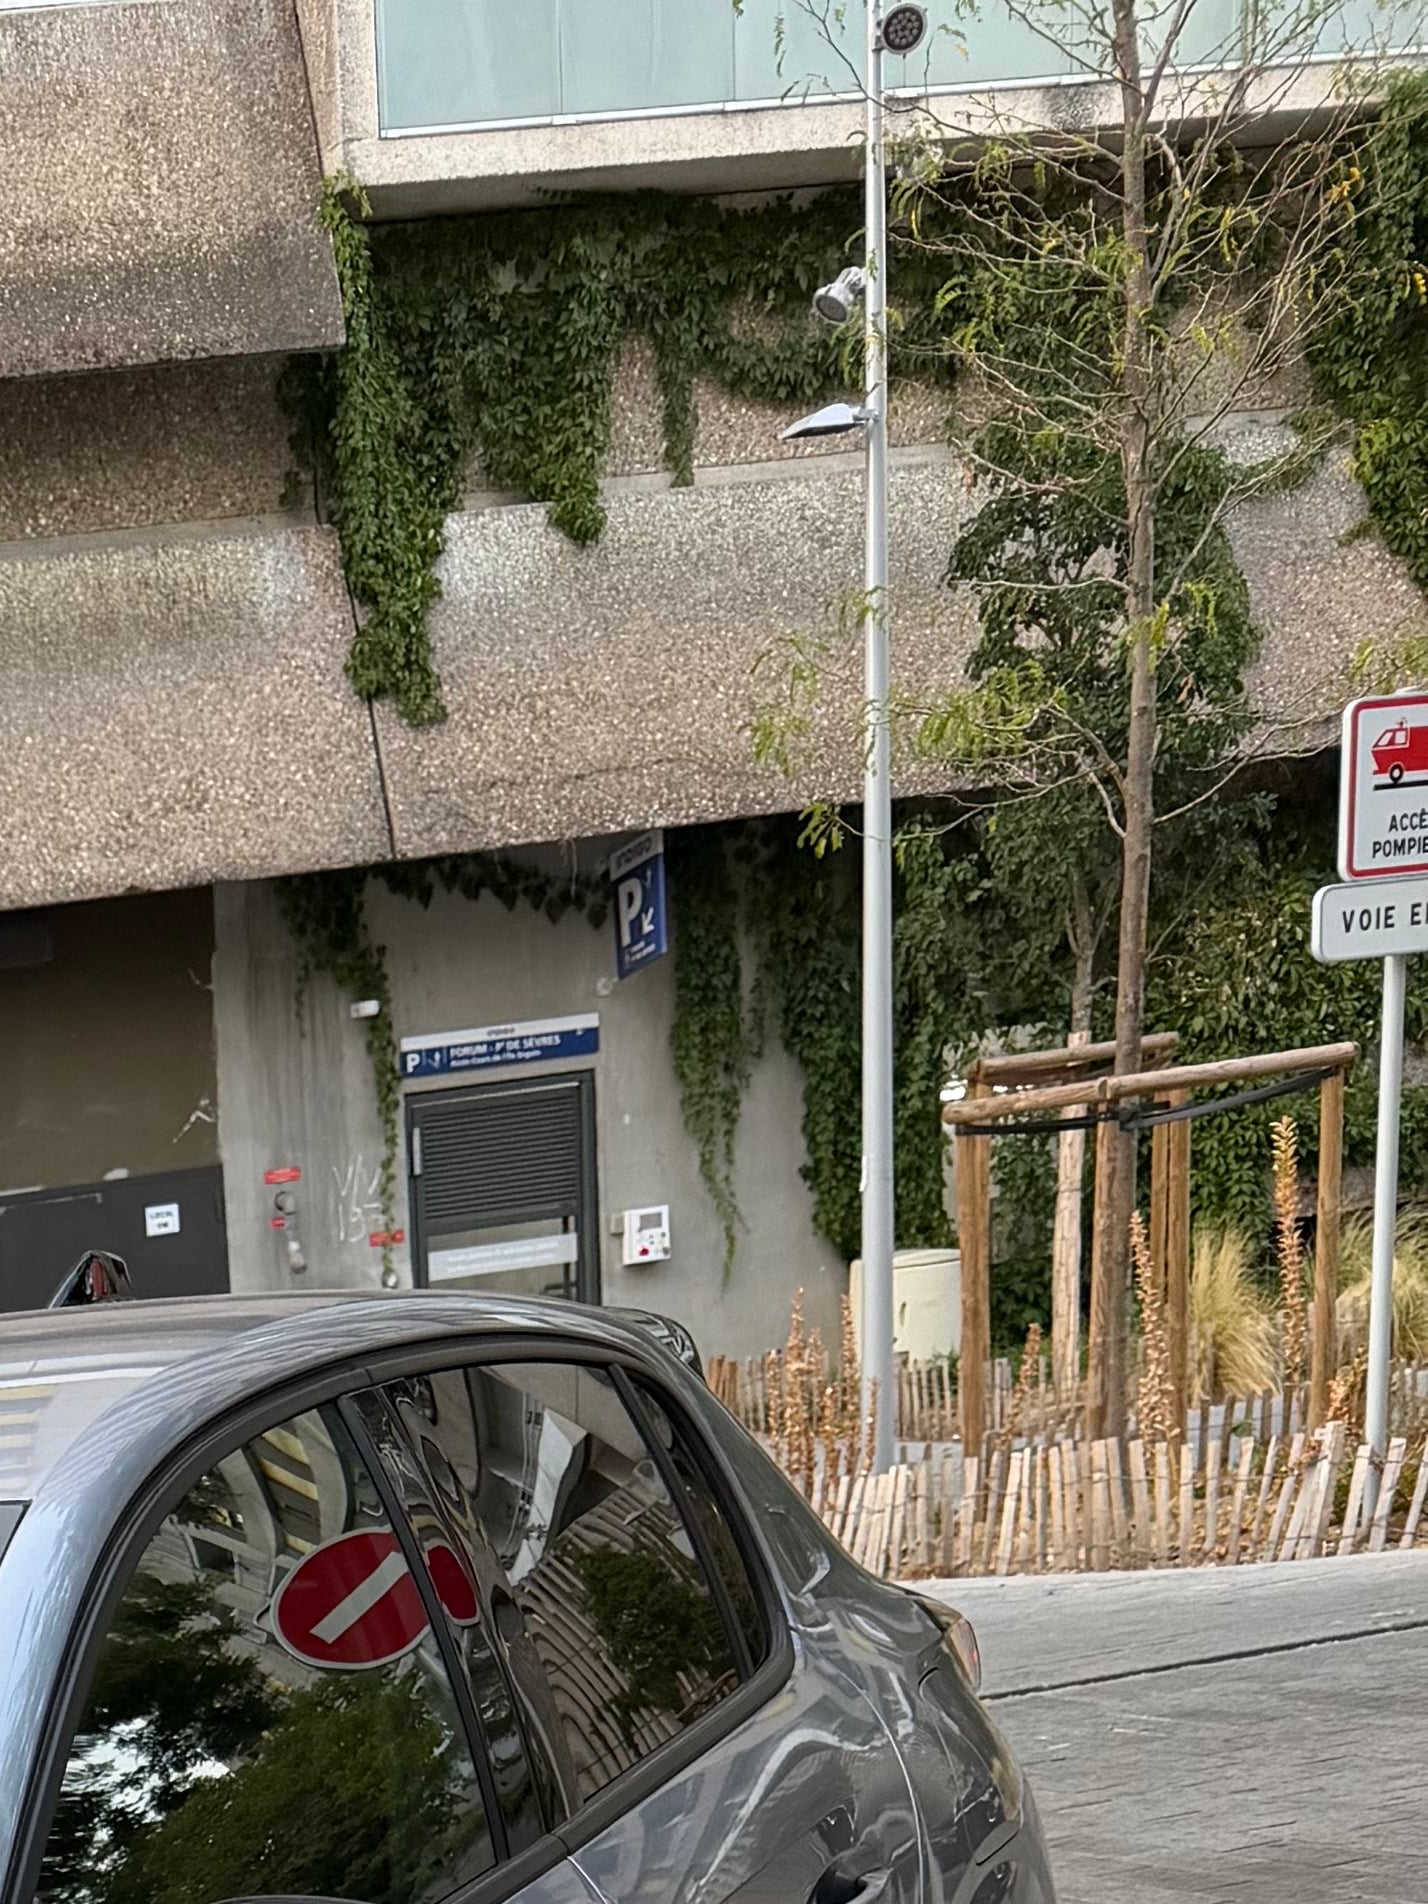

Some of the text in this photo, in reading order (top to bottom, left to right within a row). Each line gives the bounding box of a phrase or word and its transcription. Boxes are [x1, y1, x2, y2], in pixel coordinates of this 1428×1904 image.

[617, 877, 643, 947] P
[1342, 902, 1428, 934] VOIE E
[406, 1053, 420, 1073] P
